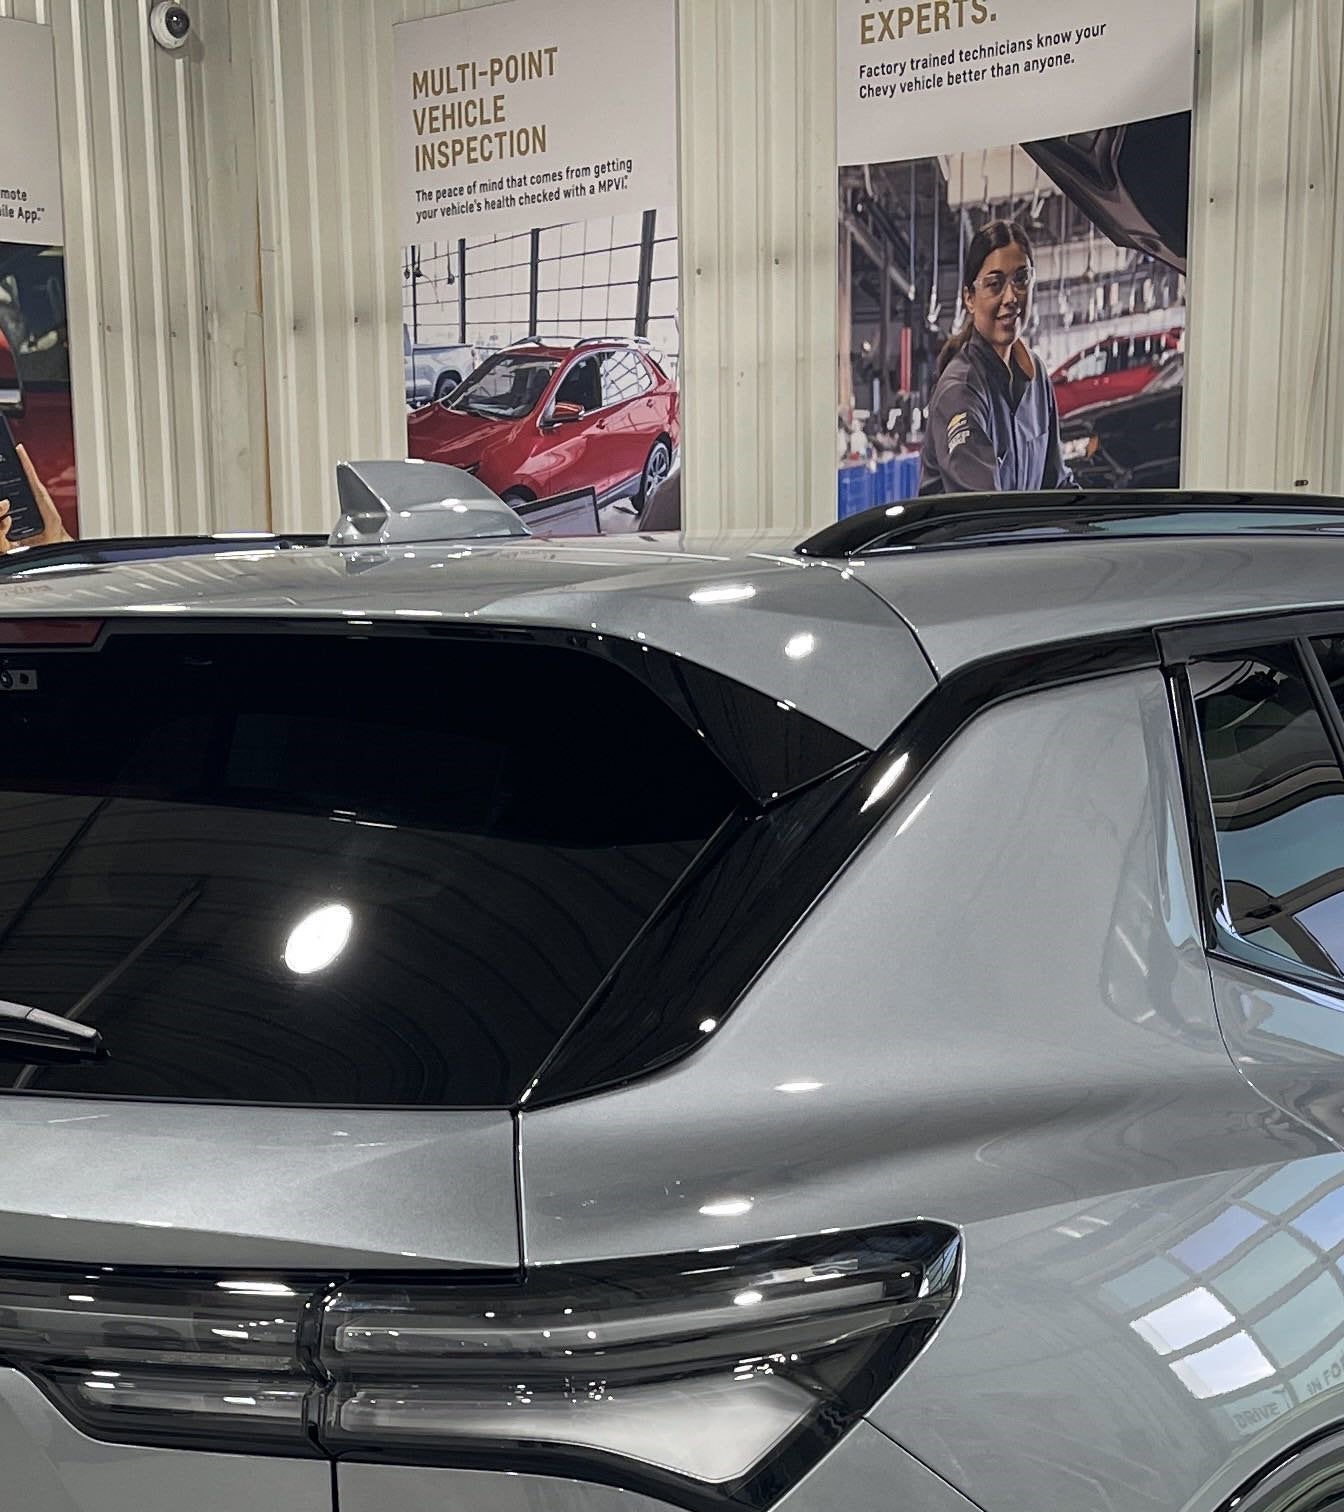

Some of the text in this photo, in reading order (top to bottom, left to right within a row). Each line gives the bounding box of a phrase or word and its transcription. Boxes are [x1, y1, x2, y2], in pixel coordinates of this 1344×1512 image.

[859, 0, 997, 45] EXPERTS.
[412, 46, 558, 100] MULTI-POINT
[859, 24, 1107, 80] Factory trained technicians know your
[859, 54, 1076, 100] Chevy vehicle better than anyone.
[413, 94, 506, 136] VEHICLE
[414, 125, 547, 172] INSPECTION
[416, 158, 633, 203] The peace of mind that comes from getting
[416, 206, 438, 224] your
[440, 198, 482, 218] vehicle's
[484, 194, 516, 211] health
[518, 187, 561, 207] checked
[563, 184, 587, 200] with
[589, 186, 595, 196] a
